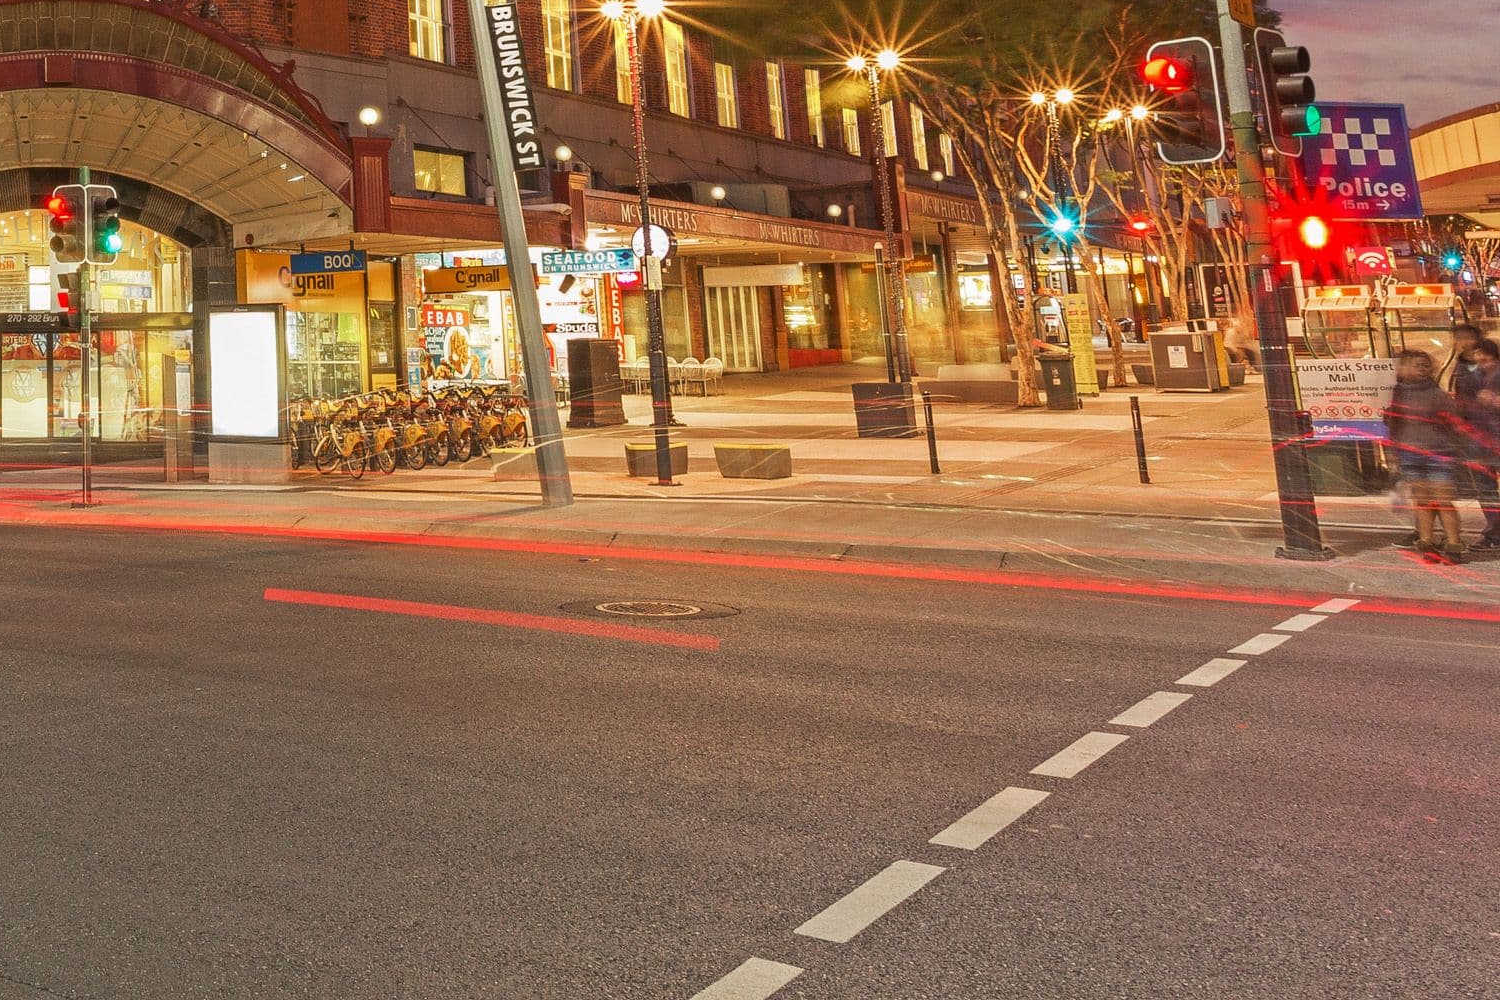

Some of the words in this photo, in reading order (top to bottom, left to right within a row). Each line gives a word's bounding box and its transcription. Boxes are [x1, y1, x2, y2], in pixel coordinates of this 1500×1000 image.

[491, 6, 535, 137] BRUNSWICK
[516, 141, 540, 166] ST
[1320, 177, 1406, 197] Police
[324, 254, 351, 269] BOQ
[543, 251, 616, 265] SEAFOOD
[278, 266, 335, 297] Cgnall
[7, 314, 21, 323] 270
[27, 313, 42, 323] 292
[556, 322, 598, 334] Spuds
[1296, 362, 1353, 371] runswick
[1355, 362, 1394, 371] Street
[1328, 373, 1356, 382] Mall
[1312, 424, 1342, 434] itySafe
